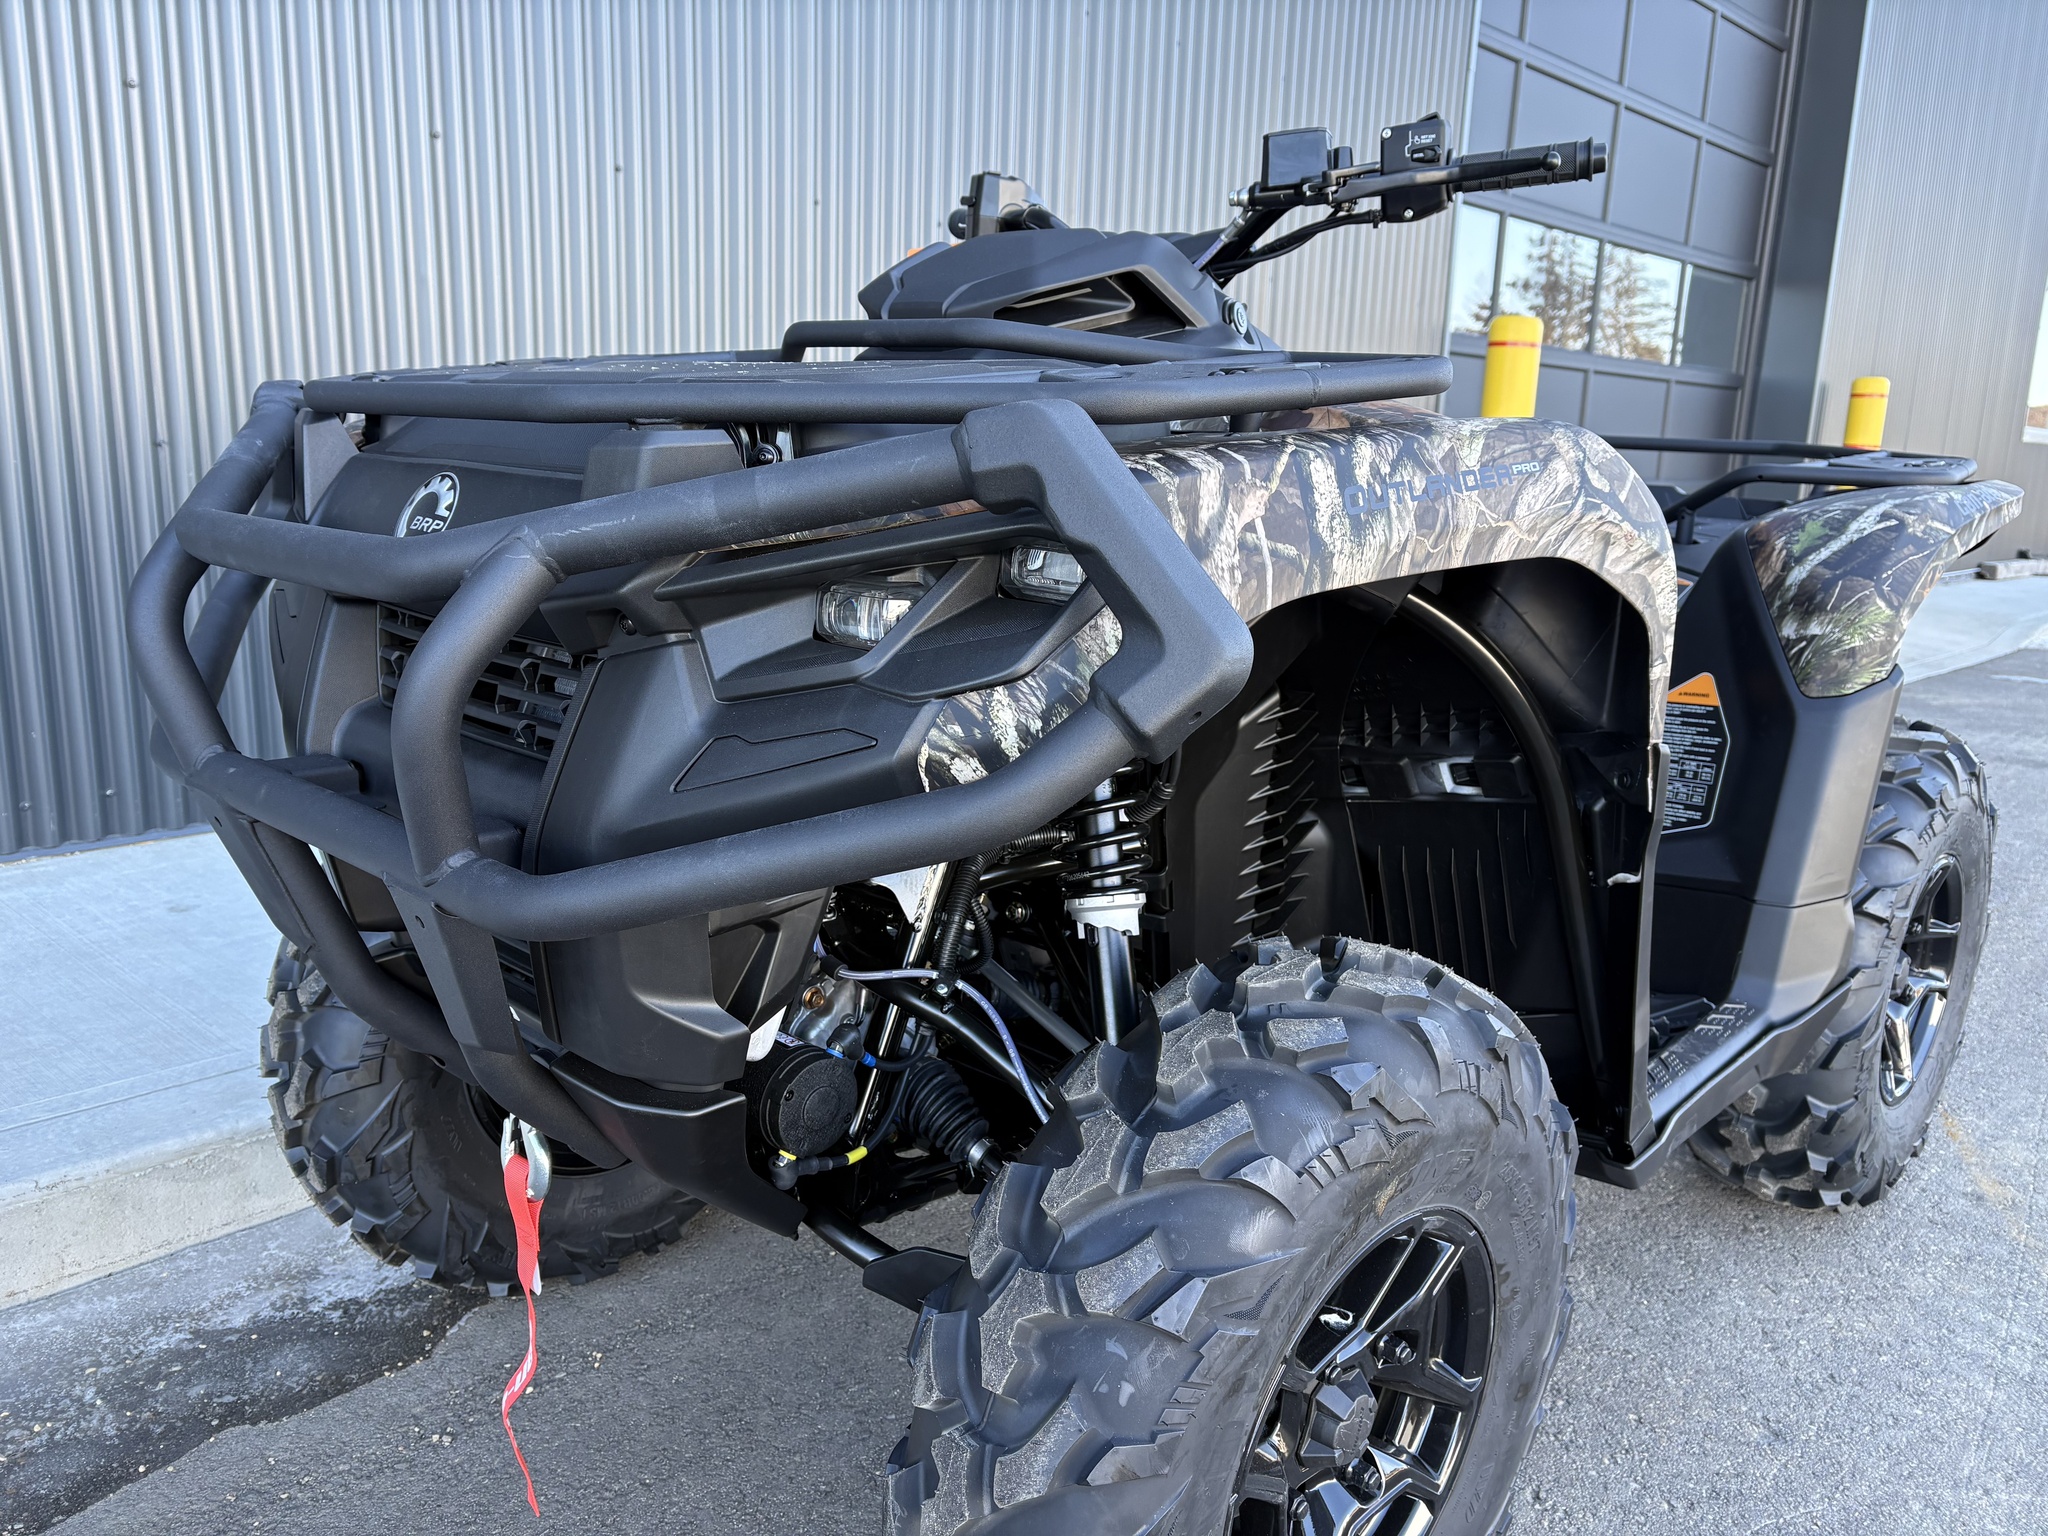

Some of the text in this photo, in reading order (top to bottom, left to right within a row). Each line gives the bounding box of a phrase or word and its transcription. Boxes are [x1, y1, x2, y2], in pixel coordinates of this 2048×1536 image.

[1343, 461, 1541, 516] OUTLANDER PRO
[409, 515, 444, 533] BRP
